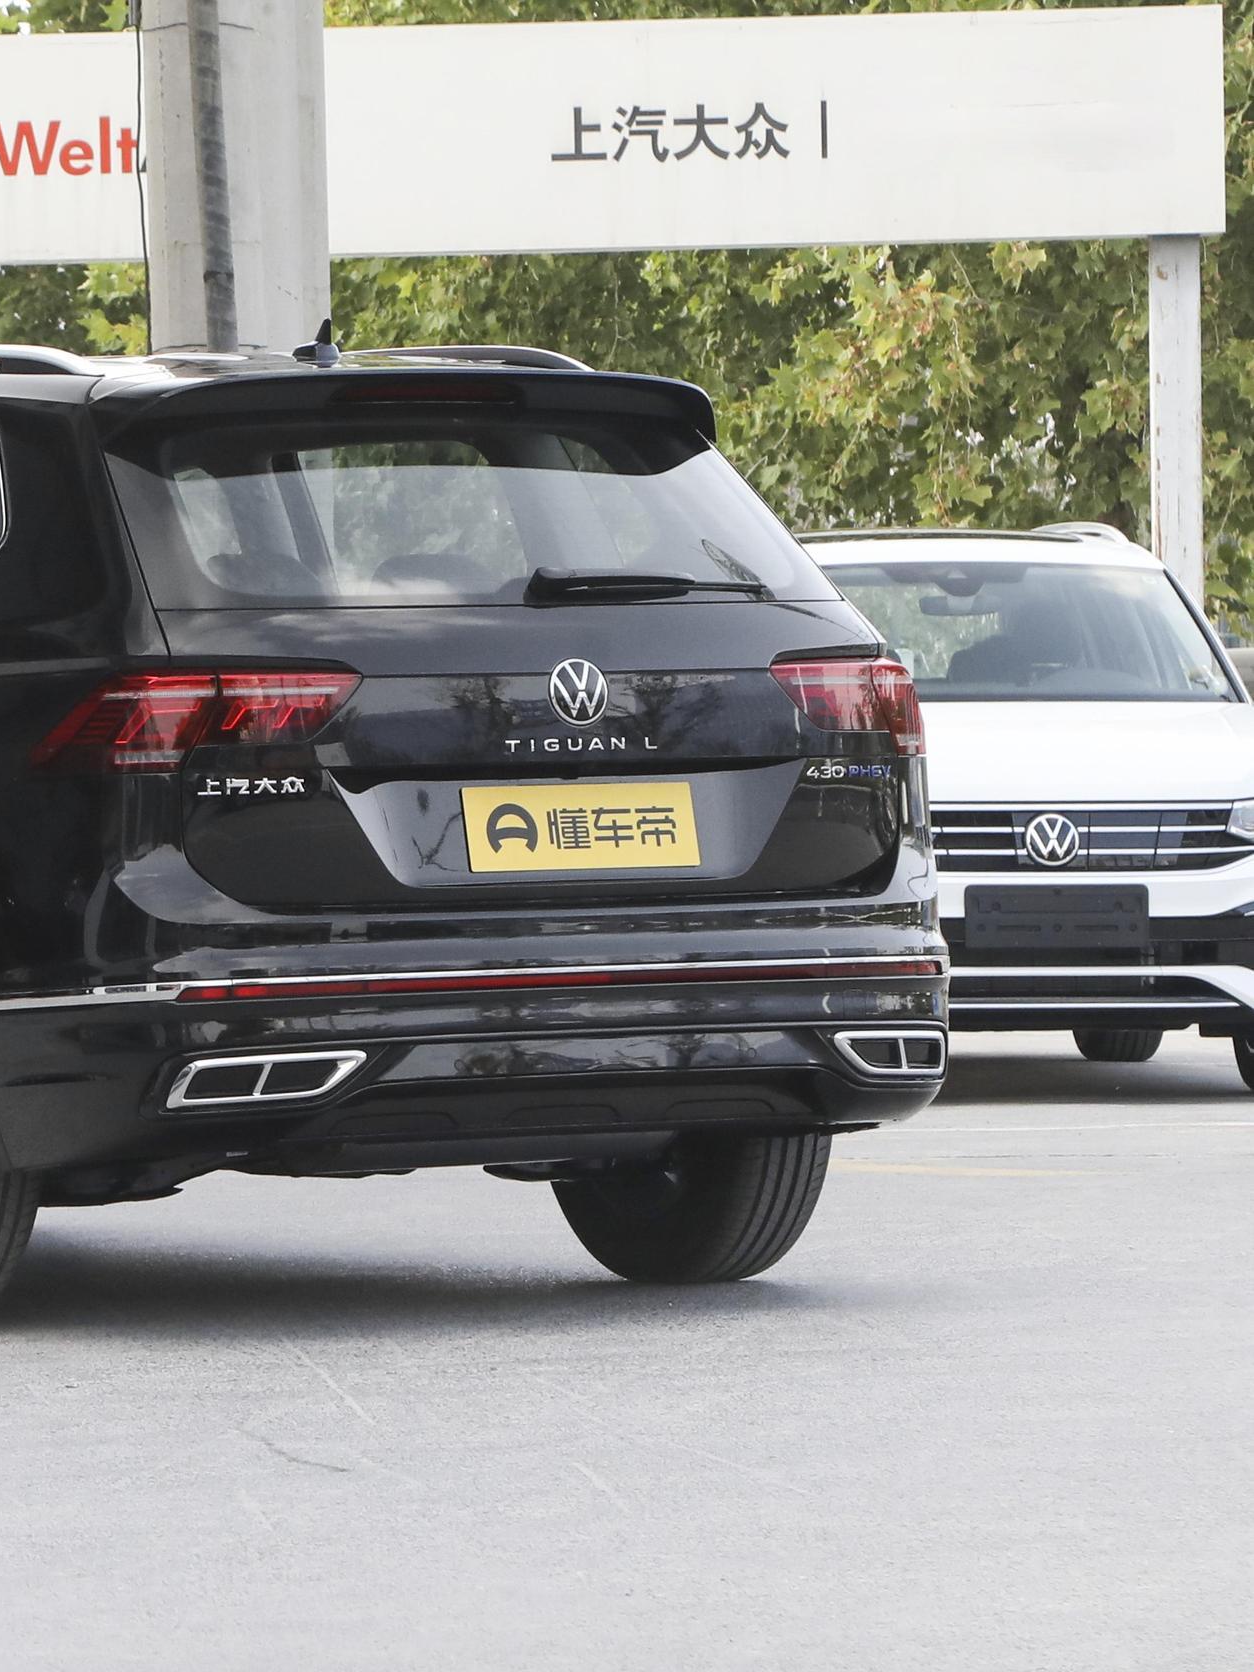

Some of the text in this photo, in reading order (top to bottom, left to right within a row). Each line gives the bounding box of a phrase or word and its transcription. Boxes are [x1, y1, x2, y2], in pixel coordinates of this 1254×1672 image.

[550, 102, 791, 163] 上汽大众
[505, 737, 658, 753] TIGUAN L
[806, 764, 891, 779] 430 PHEV
[197, 776, 305, 796] 上汽大众
[546, 805, 677, 850] 懂车帝
